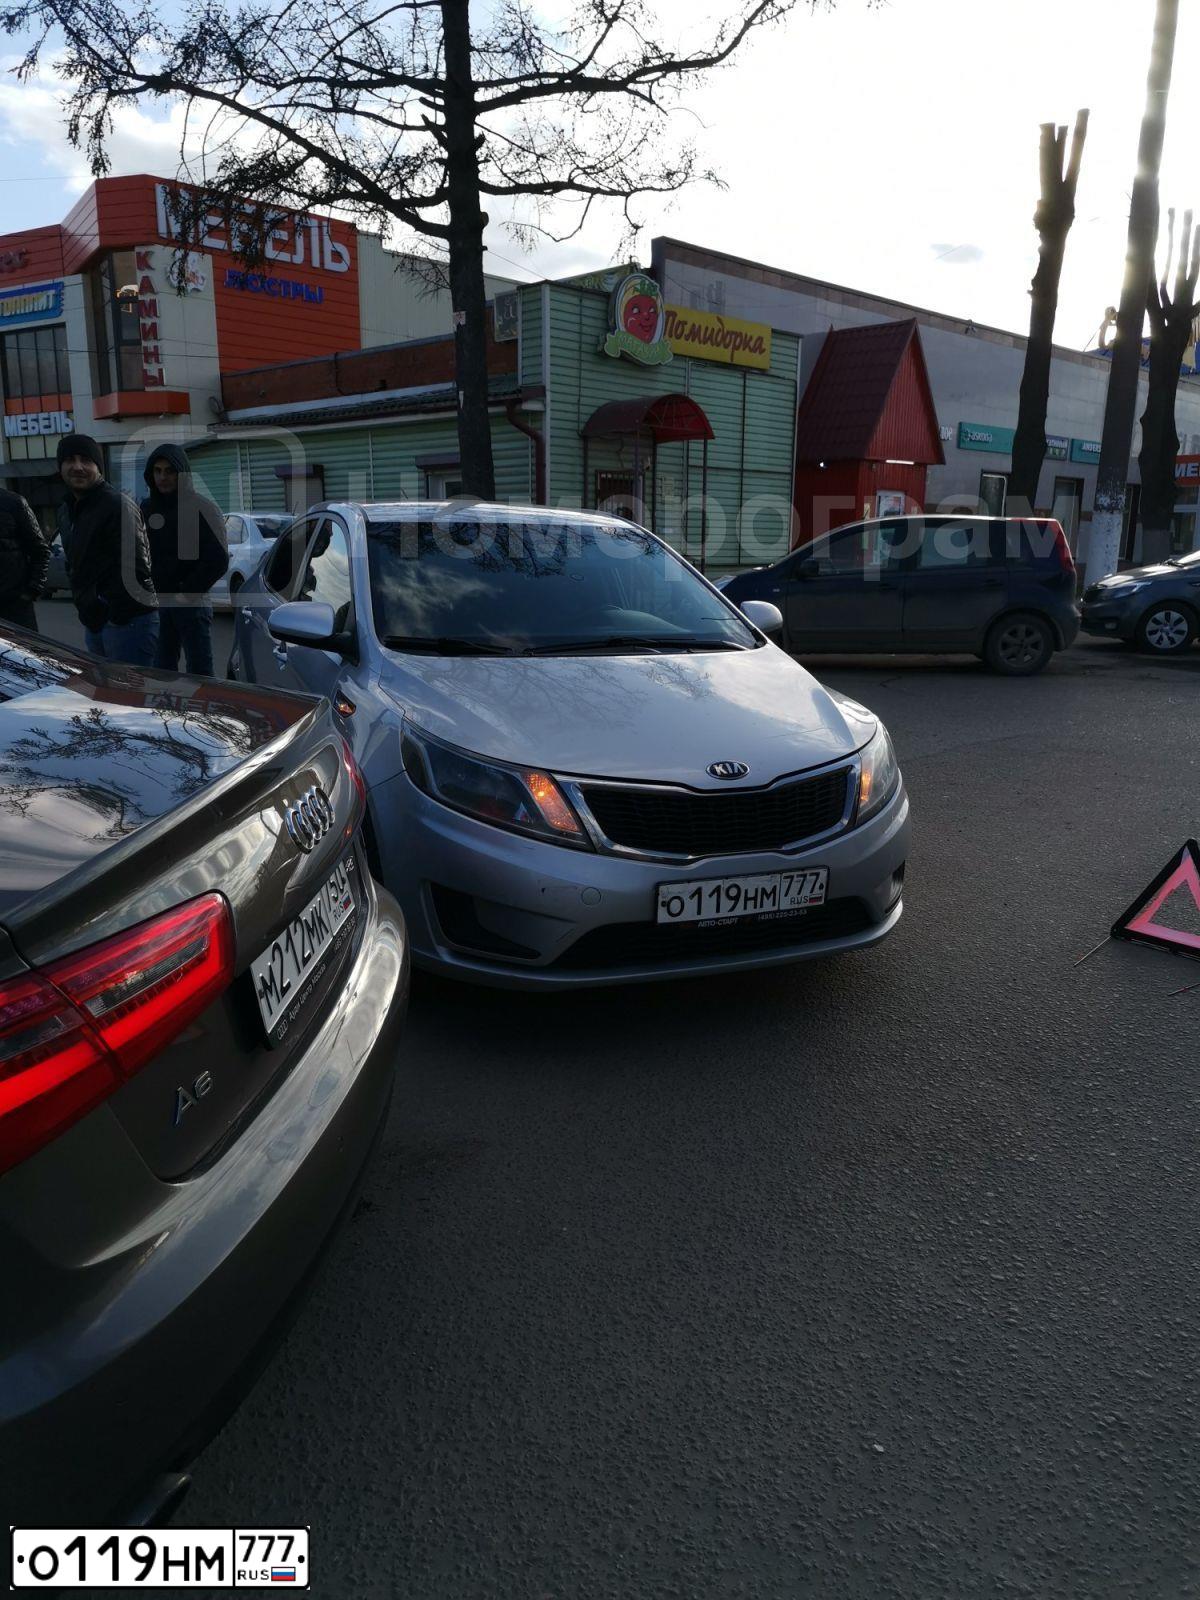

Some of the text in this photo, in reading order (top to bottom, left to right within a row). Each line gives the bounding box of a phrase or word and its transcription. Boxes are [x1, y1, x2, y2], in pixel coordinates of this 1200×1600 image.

[155, 183, 350, 272] МЕБЕЛЬ
[135, 251, 165, 387] КАМИНЫ
[664, 310, 766, 362] Помидорка
[4, 411, 73, 437] МЕБЕЛЬ
[712, 763, 744, 775] KIA
[666, 883, 777, 918] О119НМ
[783, 872, 820, 897] 777
[790, 896, 809, 905] RUS
[176, 1071, 211, 1124] A6
